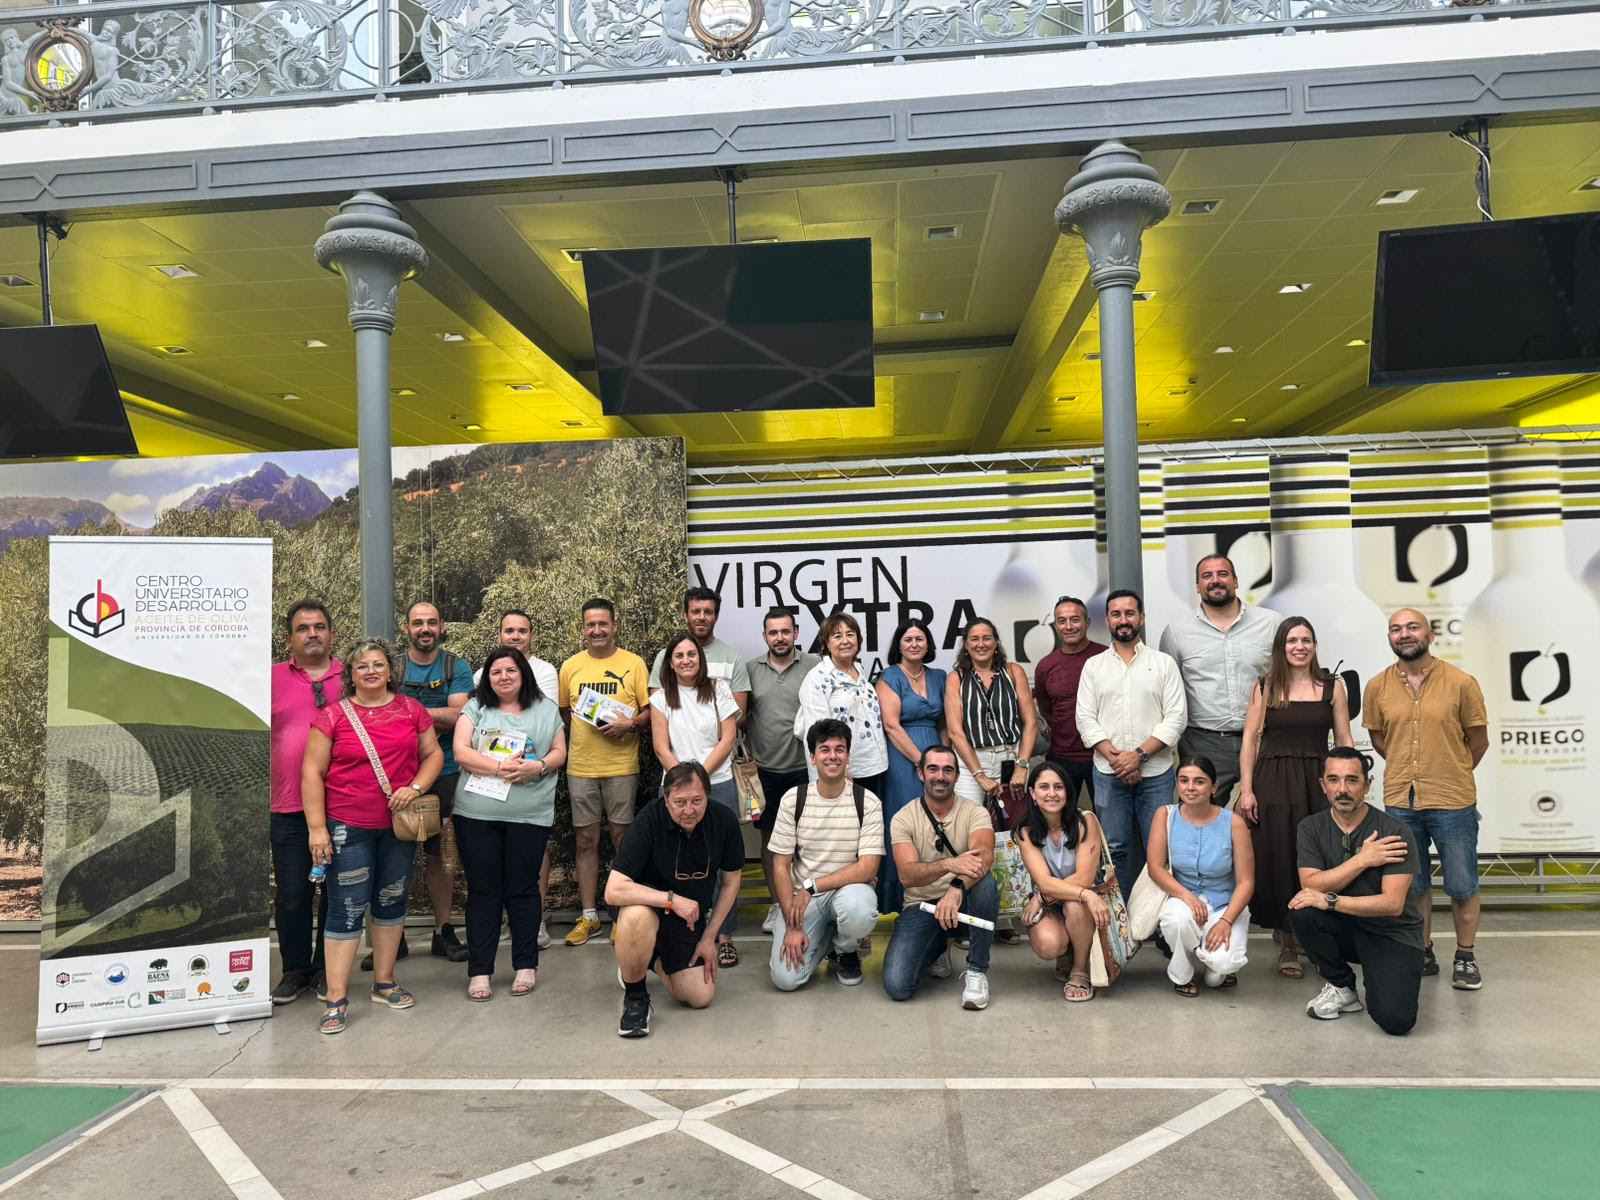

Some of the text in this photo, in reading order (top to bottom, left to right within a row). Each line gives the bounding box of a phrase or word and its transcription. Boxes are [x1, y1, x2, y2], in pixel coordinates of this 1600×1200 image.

[135, 575, 203, 587] CENTRO
[693, 555, 910, 609] VIRGEN
[135, 587, 249, 600] UNIVERSITARIO
[135, 600, 247, 612] DESARROLLO
[135, 614, 248, 624] ACEITE DE OLIVA
[134, 624, 186, 633] PROVINCIA
[189, 624, 201, 632] DE
[1500, 728, 1585, 745] PRIEGO
